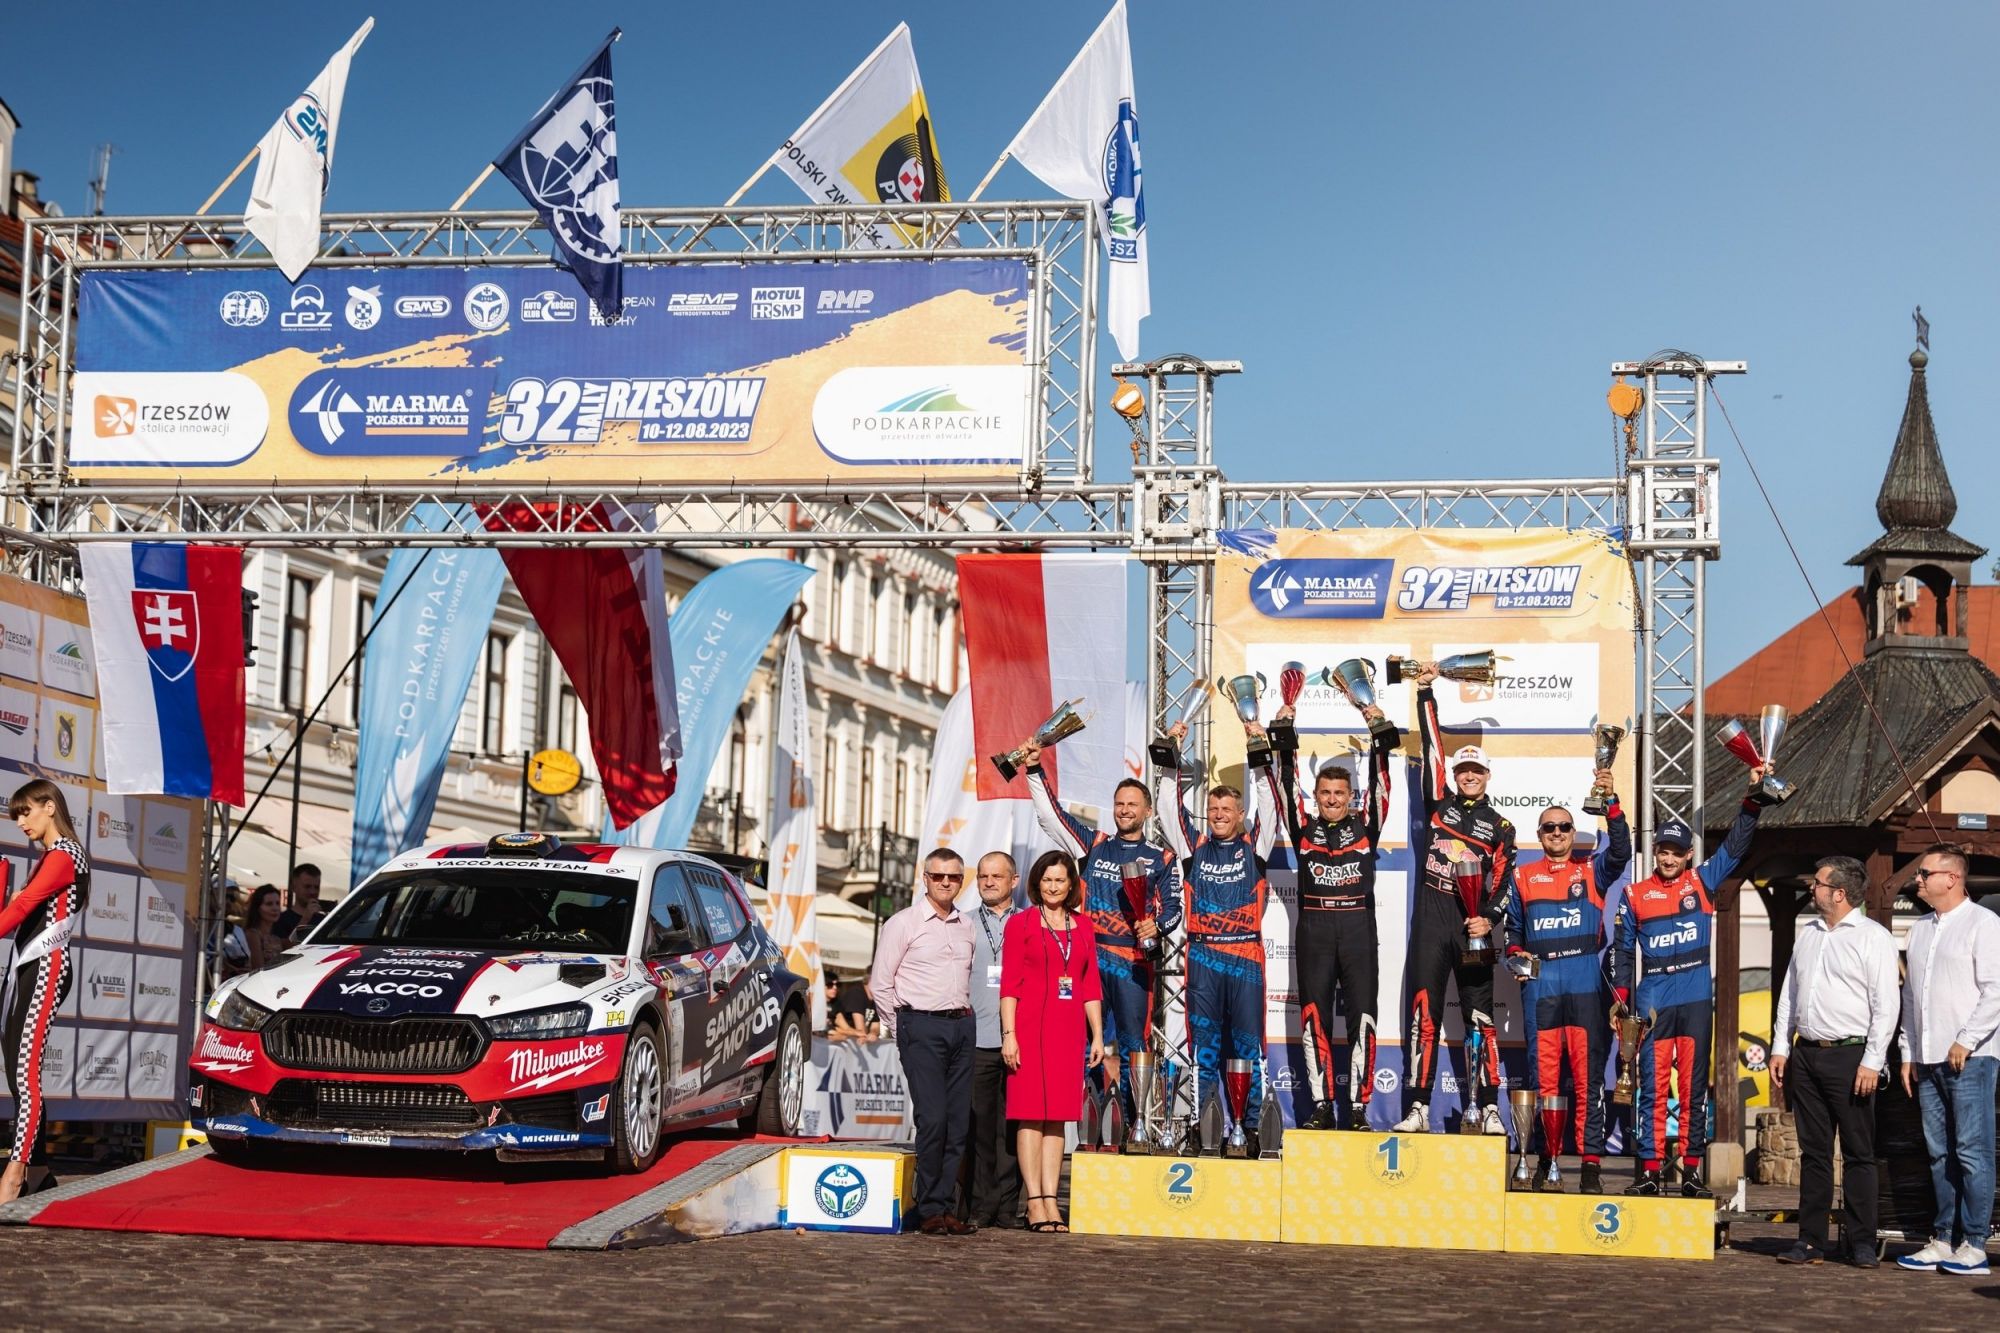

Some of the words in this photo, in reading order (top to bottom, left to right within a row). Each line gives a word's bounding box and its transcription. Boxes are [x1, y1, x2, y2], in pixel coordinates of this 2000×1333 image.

[780, 139, 827, 186] POLSKI
[754, 290, 802, 300] MOTUL
[817, 290, 874, 309] RMP
[524, 302, 541, 310] AUTO
[524, 310, 540, 318] KLUB
[142, 402, 231, 420] rzeszów
[502, 380, 581, 441] 32
[574, 383, 608, 441] RALLY
[366, 415, 423, 425] POLSKIE
[428, 415, 469, 425] FOLIE
[853, 416, 1000, 431] PODKARPACKIE
[141, 422, 176, 434] stolica
[179, 422, 230, 437] innowacji
[642, 422, 749, 439] 10-12.08.2023
[1348, 590, 1376, 598] FOLIE
[1400, 567, 1454, 610] 32
[1450, 569, 1473, 609] RALLY
[1497, 595, 1571, 607] 10-12.08.2023
[1498, 675, 1573, 689] rzeszów
[1498, 690, 1528, 700] stolica
[1530, 689, 1573, 702] innowacji
[435, 860, 492, 868] YACCO
[493, 860, 542, 868] ACCR
[544, 862, 589, 872] TEAM
[1426, 853, 1452, 877] Red
[1533, 912, 1581, 931] verva
[1649, 927, 1698, 948] verva
[338, 982, 443, 998] YACCO
[722, 997, 781, 1064] MOTOR
[200, 1029, 254, 1063] Milwaukee
[504, 1041, 605, 1083] Milwaukee
[853, 1073, 905, 1095] MARMA
[214, 1123, 248, 1132] MICHELIN
[522, 1134, 579, 1143] MICHELIN
[1378, 1135, 1399, 1170] 1
[1168, 1162, 1193, 1194] 2
[1381, 1170, 1405, 1181] PZM
[1169, 1194, 1192, 1204] PZM
[1594, 1202, 1620, 1234] 3
[1595, 1233, 1620, 1244] PZM
